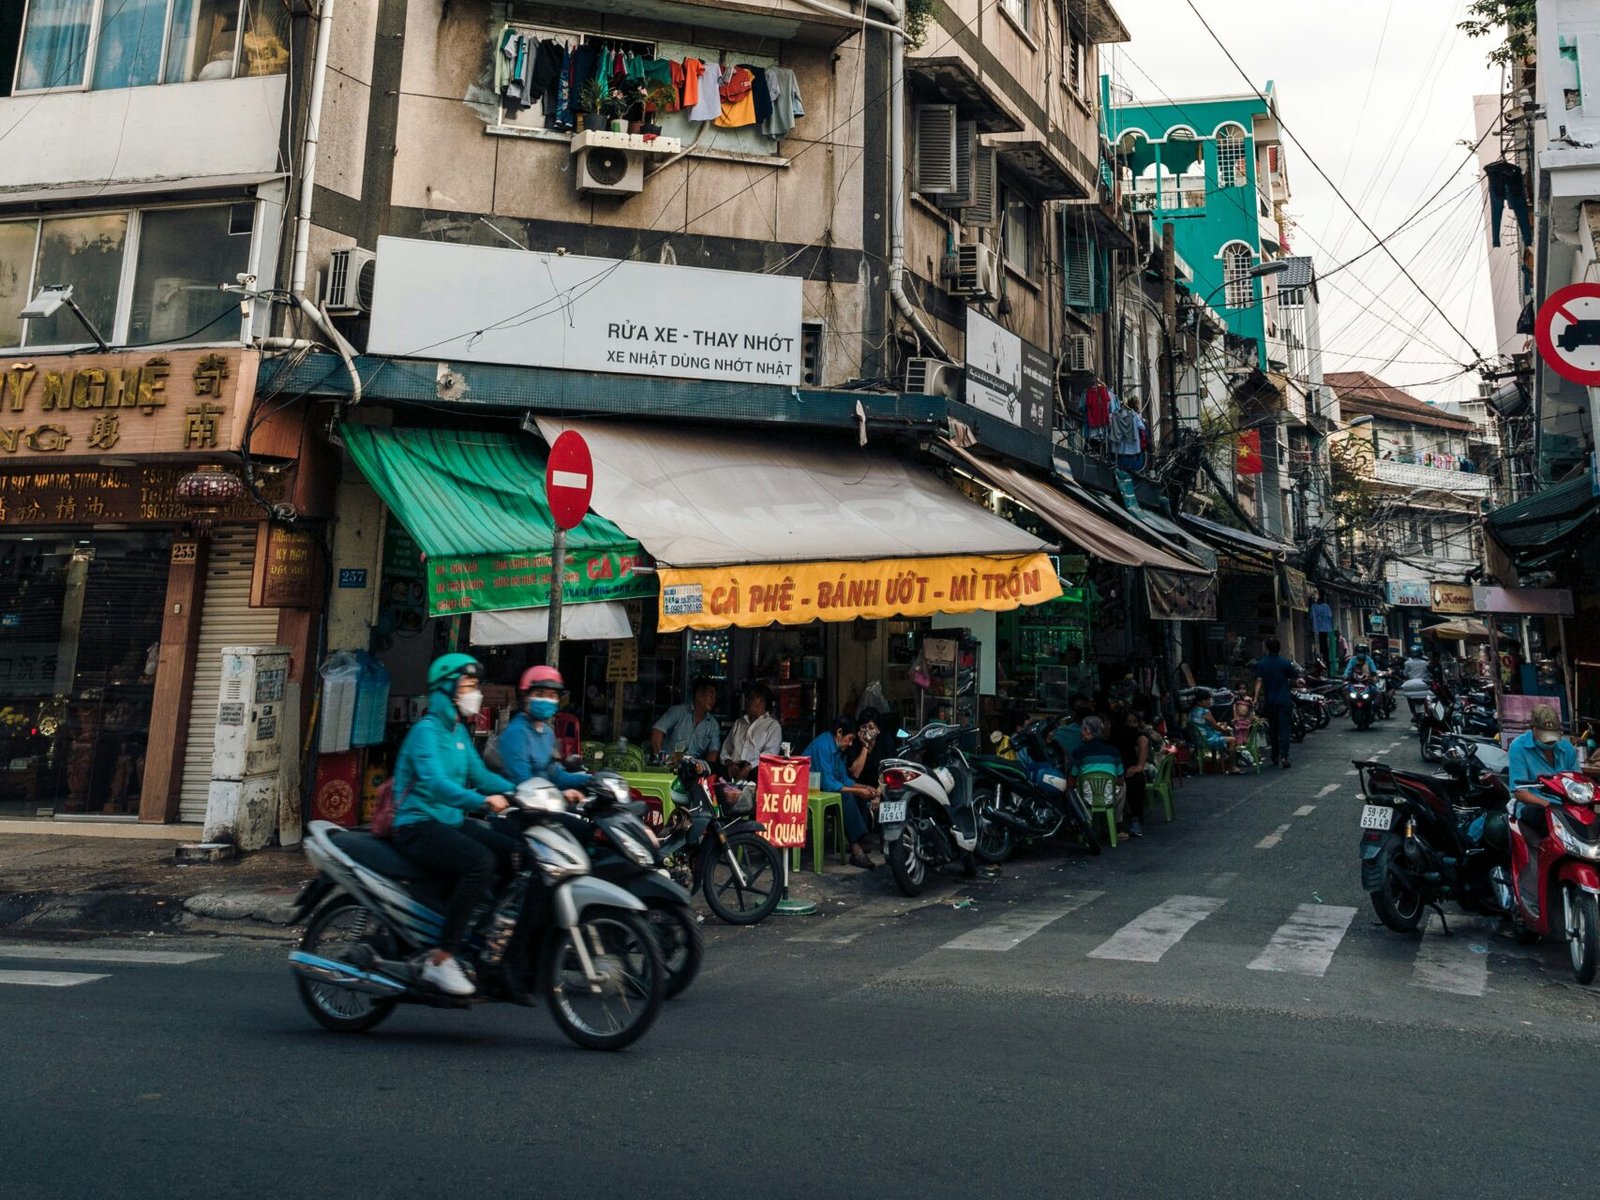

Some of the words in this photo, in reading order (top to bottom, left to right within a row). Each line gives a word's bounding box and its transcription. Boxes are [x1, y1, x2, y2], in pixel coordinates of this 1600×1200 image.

[608, 319, 649, 341] RỬA
[654, 326, 678, 343] XE
[693, 330, 738, 348] THAY
[744, 333, 794, 353] NHỚT
[606, 350, 625, 363] XE
[629, 351, 667, 369] NHẬT
[671, 353, 710, 370] DÙNG
[714, 357, 753, 373] NHỚT
[756, 361, 793, 379] NHẬT
[0, 362, 38, 412] Ỹ
[42, 356, 171, 416] NGHỆ
[173, 545, 195, 559] 255
[341, 571, 365, 583] 257
[587, 554, 613, 580] CÀ
[710, 578, 740, 615] CÀ
[749, 576, 795, 612] PHÊ
[817, 573, 880, 609] BÁNH
[886, 570, 929, 605] ƯỚT
[950, 568, 978, 602] MÌ
[982, 566, 1041, 602] TRỘN
[762, 793, 780, 813] XE
[783, 789, 803, 813] ÔM
[774, 817, 805, 846] QUẢN
